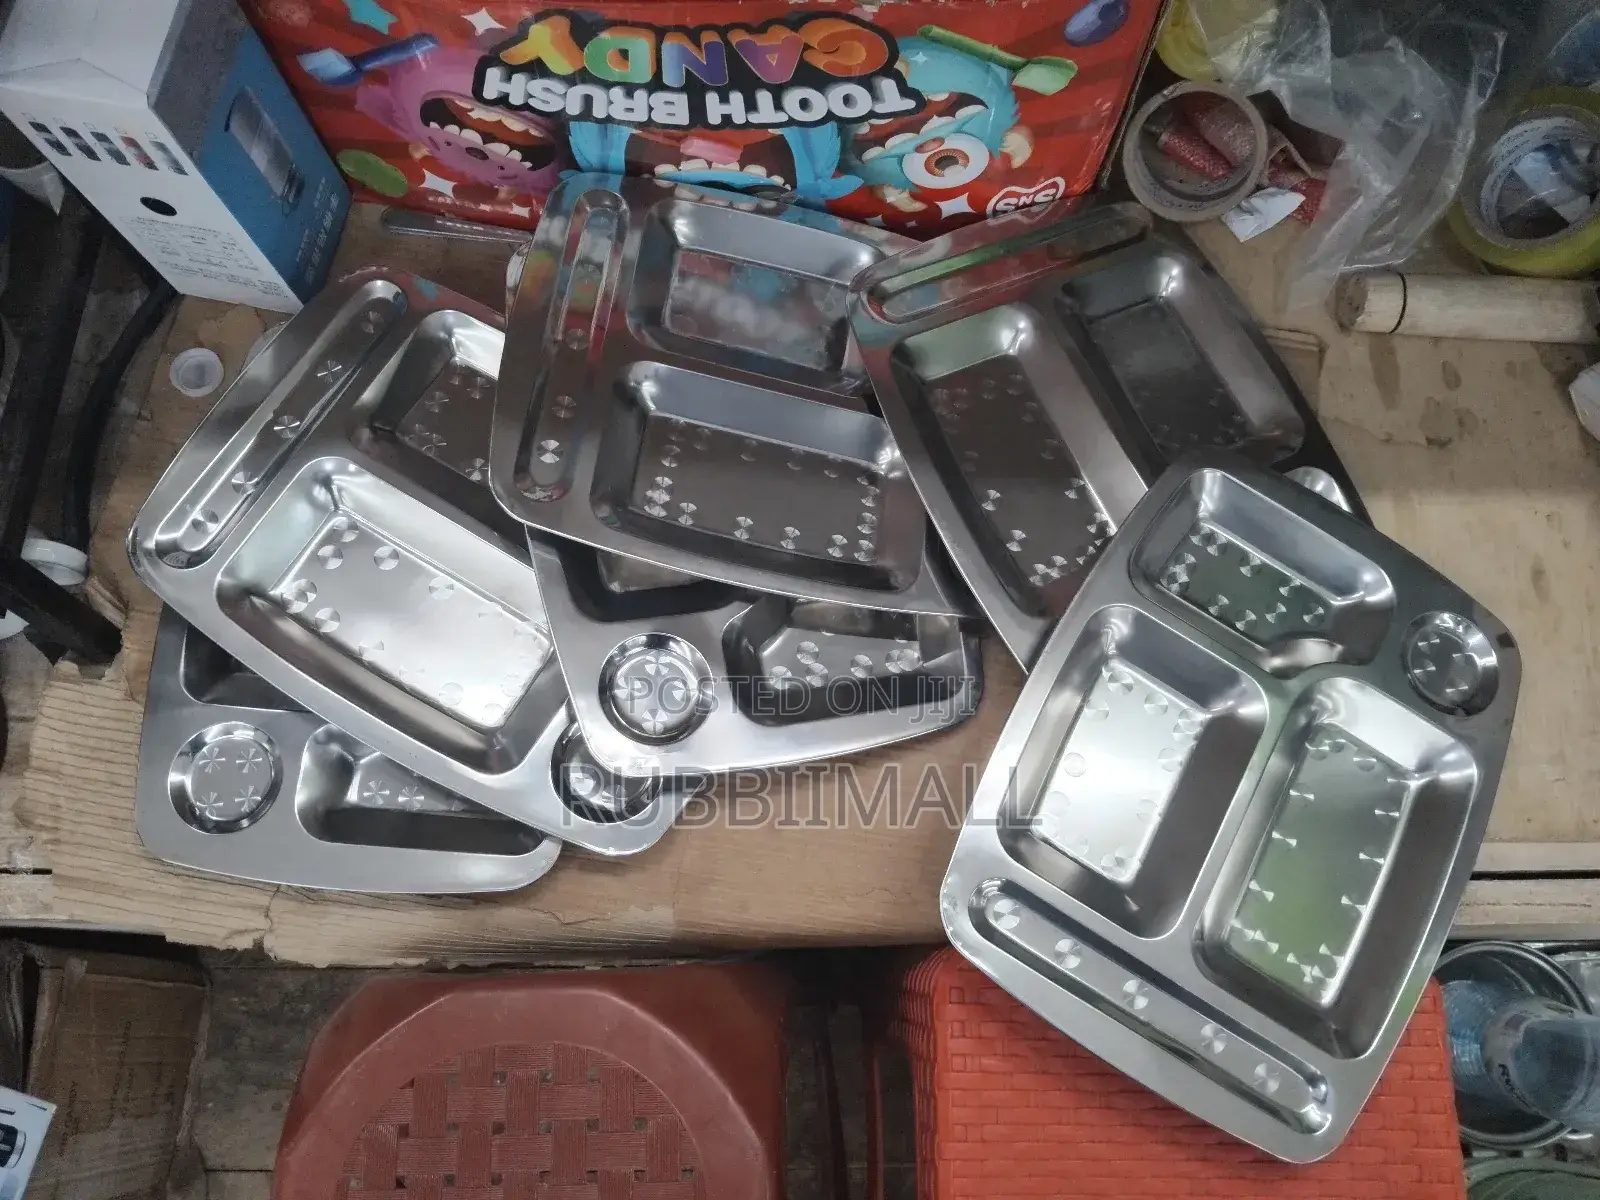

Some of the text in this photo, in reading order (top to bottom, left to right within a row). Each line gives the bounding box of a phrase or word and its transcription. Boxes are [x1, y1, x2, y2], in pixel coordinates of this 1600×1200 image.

[500, 15, 889, 88] CANDY
[482, 65, 917, 126] TOOTH BRUSH
